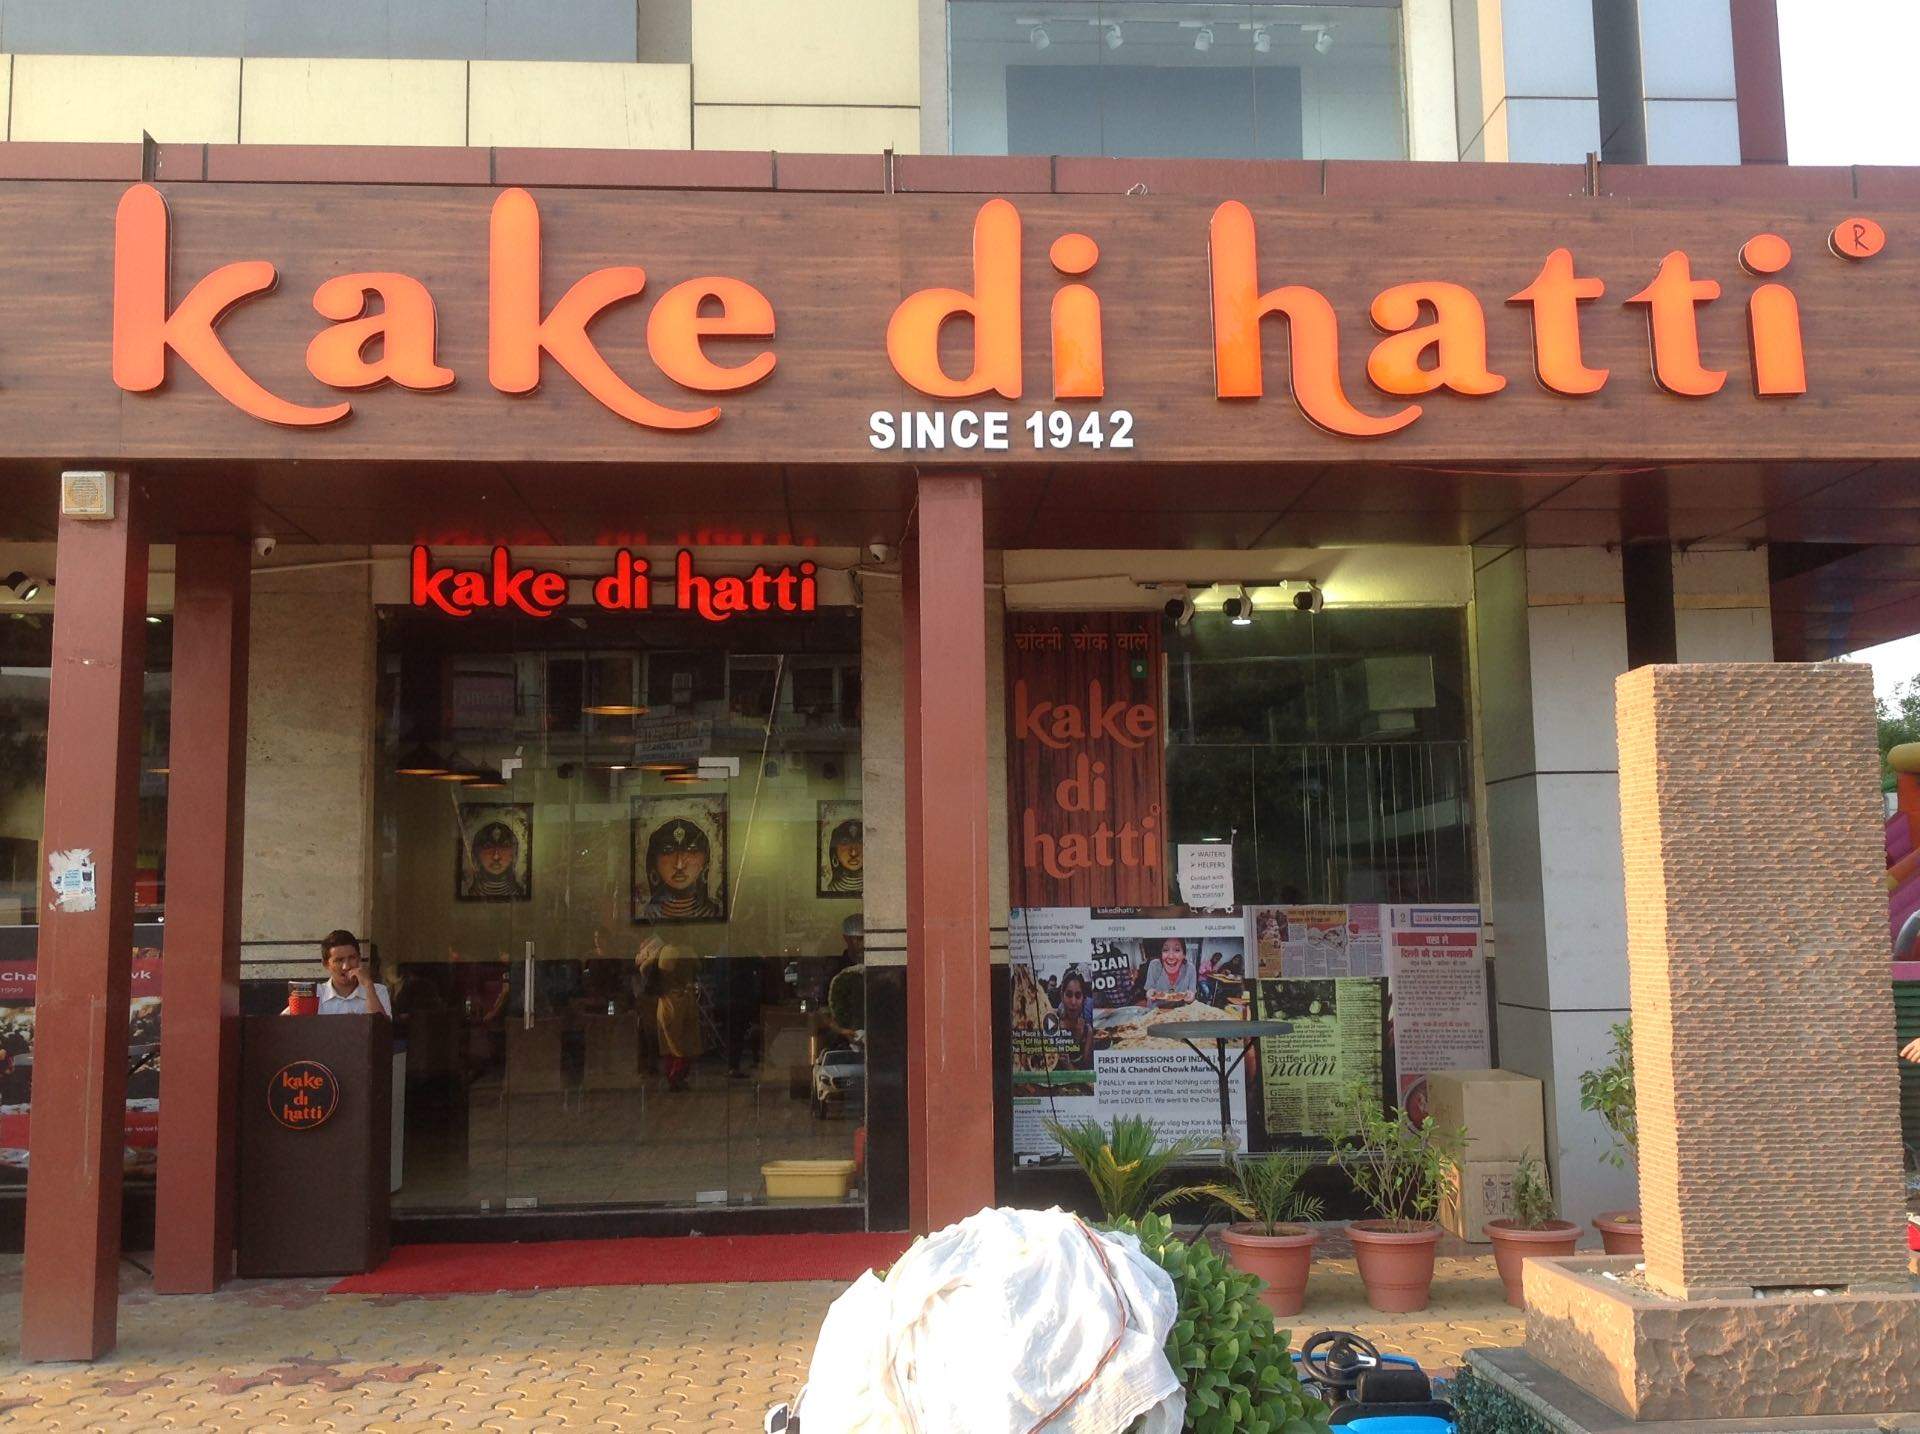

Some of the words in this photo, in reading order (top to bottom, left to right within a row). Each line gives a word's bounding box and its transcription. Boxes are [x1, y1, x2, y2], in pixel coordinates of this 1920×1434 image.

[111, 183, 779, 429] kake
[886, 197, 1106, 400] di
[1206, 199, 1808, 437] hatti
[868, 409, 1009, 450] SINCE
[1025, 409, 1135, 449] 1942
[411, 545, 567, 617] kake
[595, 551, 648, 610] di
[676, 552, 816, 622] hatti
[1014, 679, 1157, 749] kake
[1056, 752, 1107, 812] di
[1023, 806, 1157, 879] hatti
[1197, 850, 1226, 858] WAITERS
[1098, 1056, 1120, 1064] FIRST
[1267, 1055, 1307, 1063] Stuffed
[1127, 1065, 1161, 1073] Chandni
[1162, 1065, 1189, 1073] Chowk
[283, 1071, 324, 1089] kake
[294, 1089, 308, 1106] di
[284, 1104, 322, 1122] hatti
